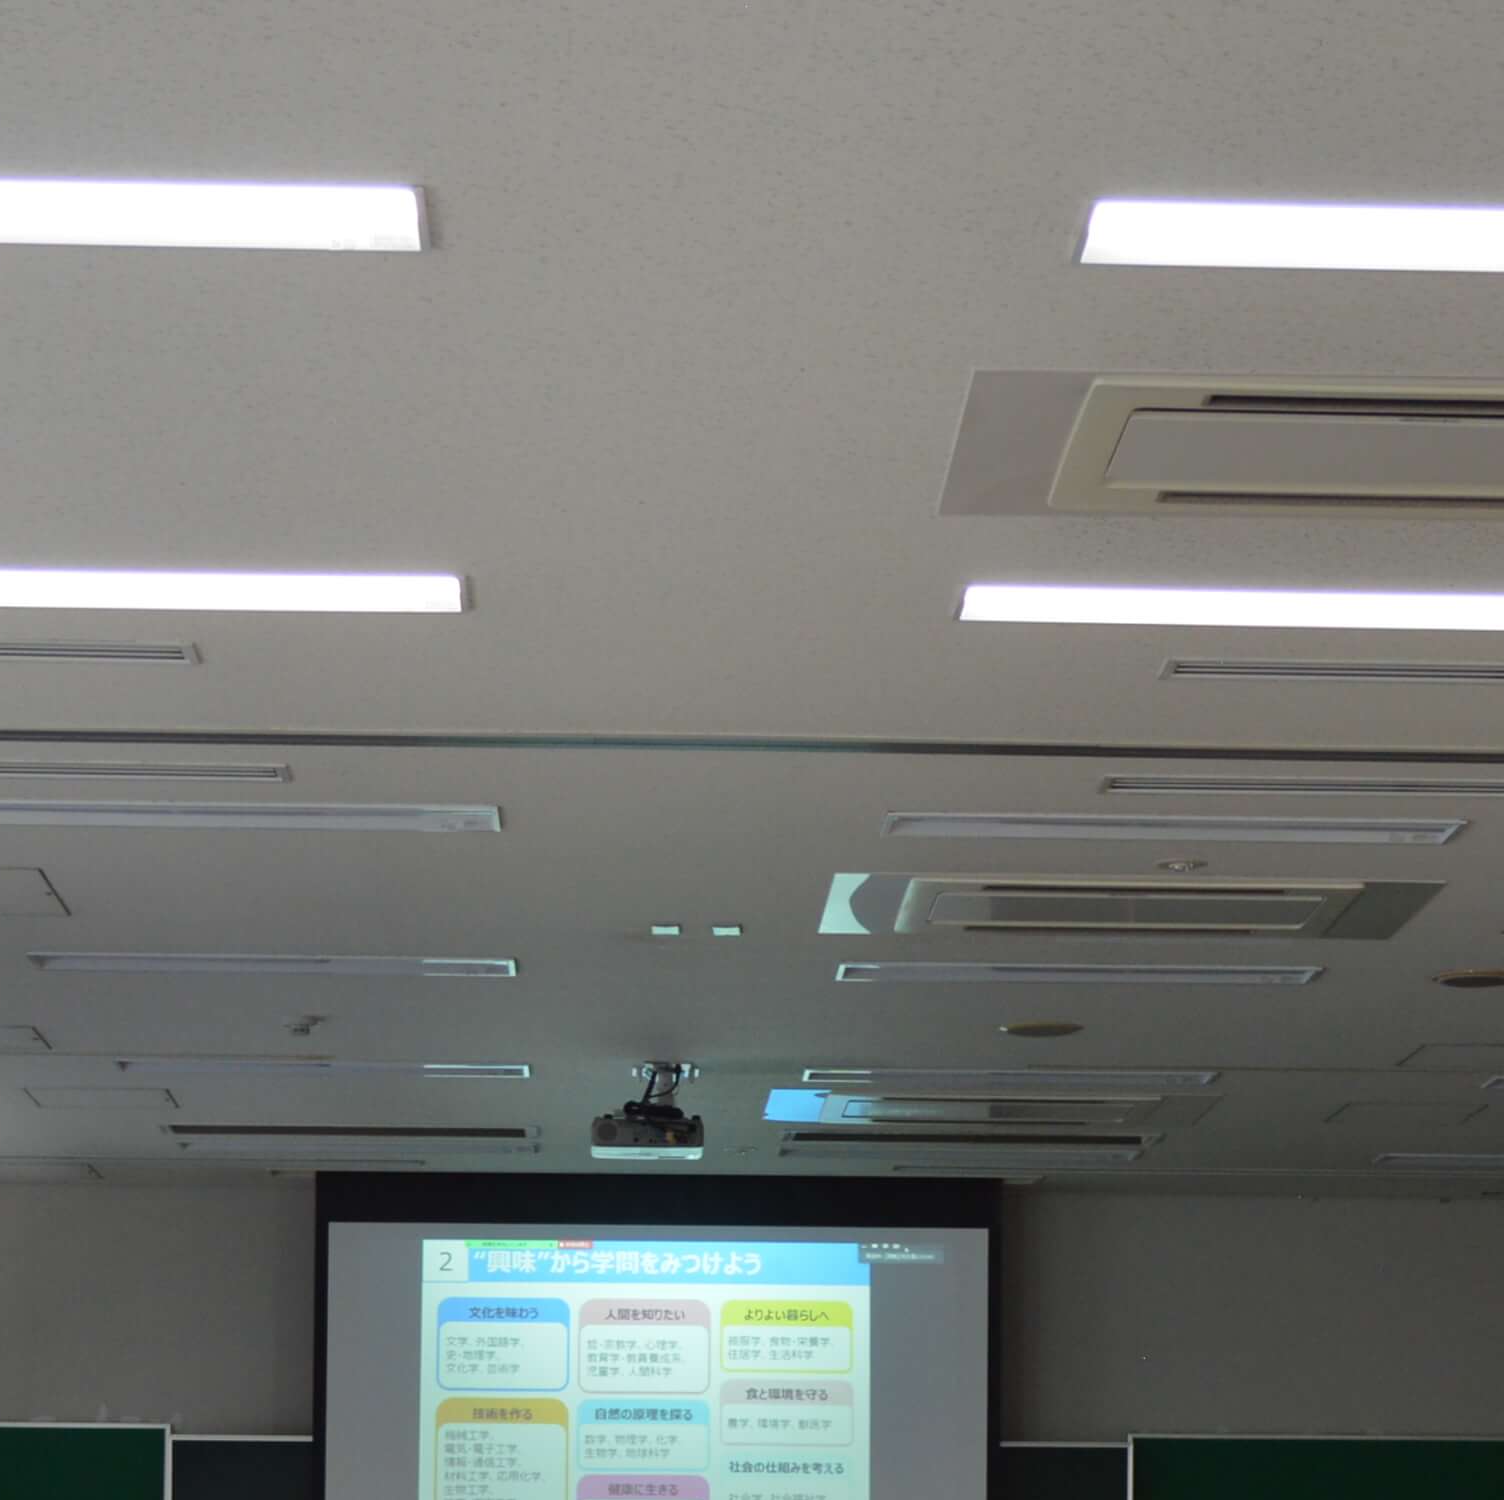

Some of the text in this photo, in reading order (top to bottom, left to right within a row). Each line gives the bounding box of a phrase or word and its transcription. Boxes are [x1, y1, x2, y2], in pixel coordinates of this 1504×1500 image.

[439, 1252, 453, 1271] 2
[468, 1306, 539, 1320] 文化を味わう
[606, 1308, 685, 1321] 人間を知りたい
[744, 1308, 830, 1322] よりよい暮らしへ
[746, 1388, 828, 1401] 食と環境を守る
[472, 1407, 533, 1421] 技術を作る
[595, 1408, 693, 1421] 自然の原理を探る
[729, 1460, 845, 1475] 社会の仕組みを考える
[608, 1483, 679, 1496] 健康に生きる
